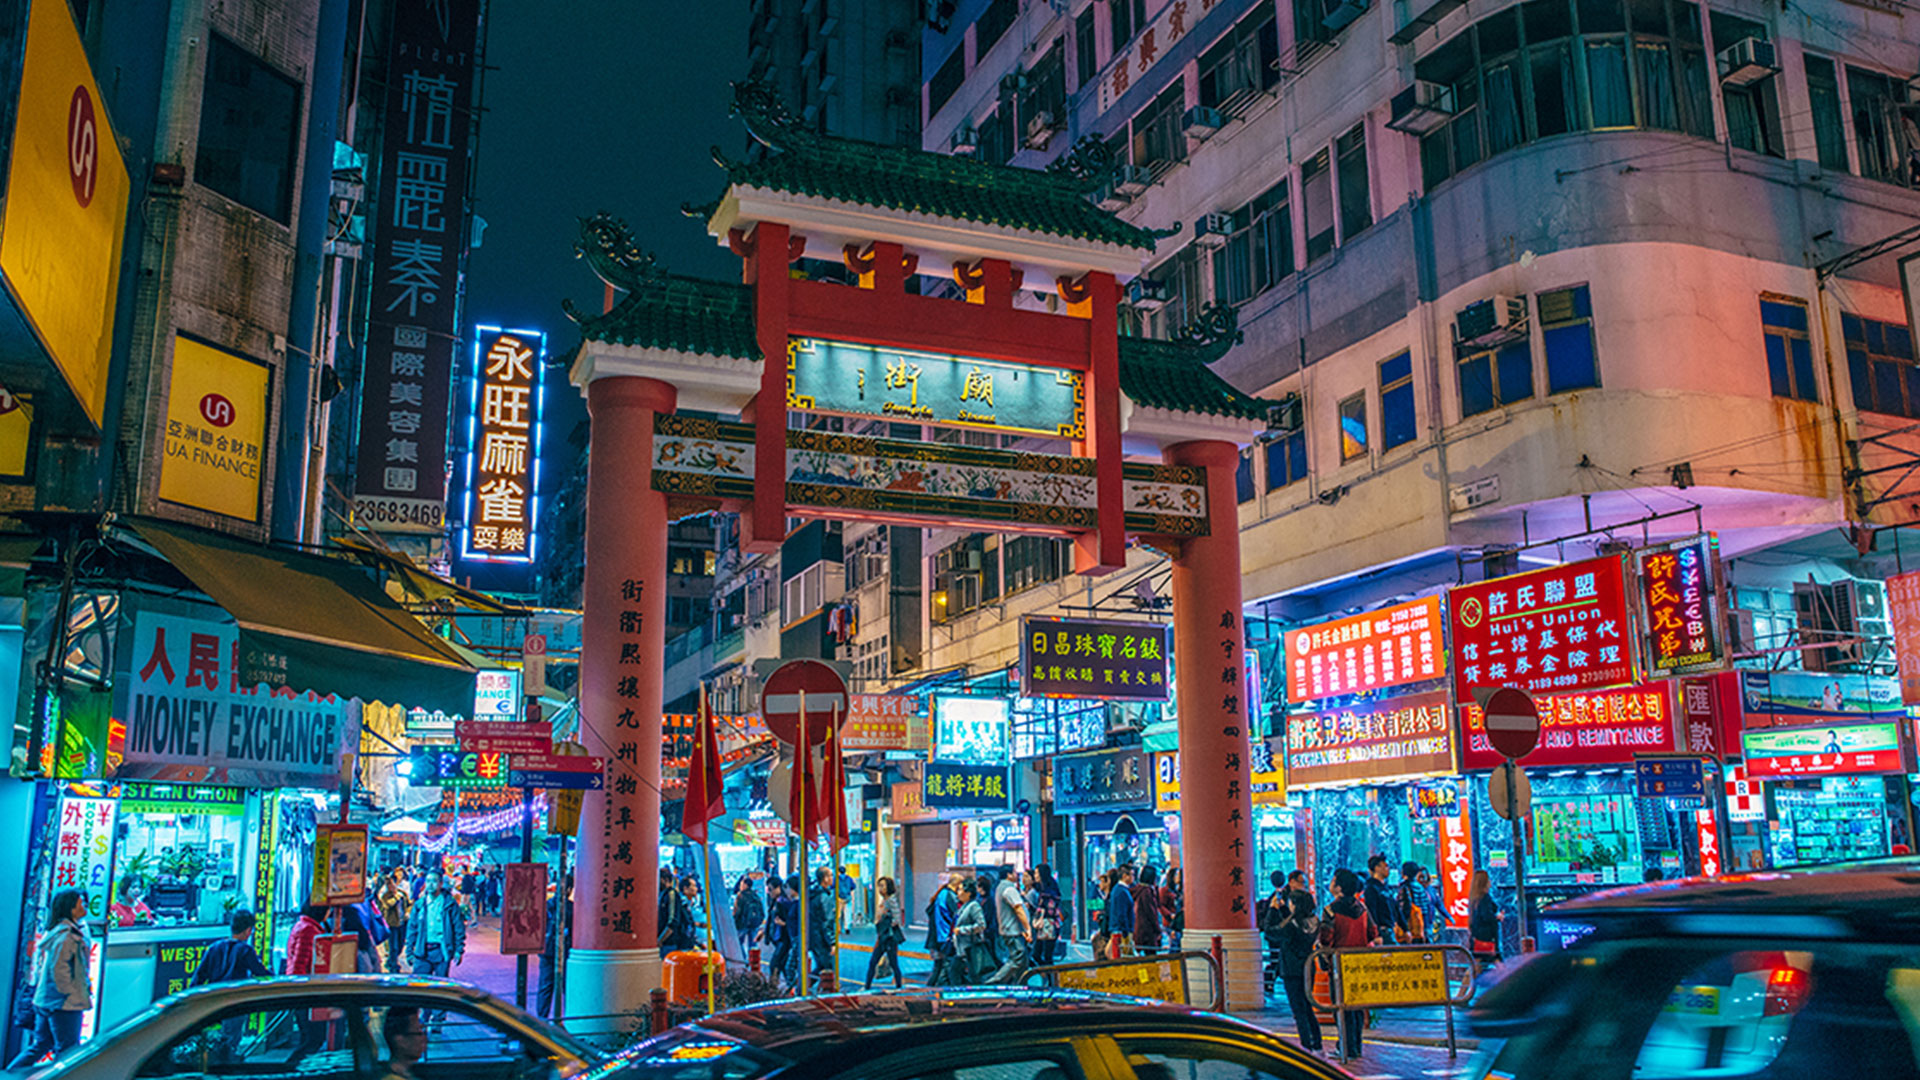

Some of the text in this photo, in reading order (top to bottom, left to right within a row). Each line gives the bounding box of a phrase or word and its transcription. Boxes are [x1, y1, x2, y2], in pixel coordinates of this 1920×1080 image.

[383, 324, 428, 492] 國際美容集團
[882, 400, 996, 425] Temple Street
[168, 419, 259, 461] 亞洲聯合財務
[479, 336, 533, 523] 永旺麻雀
[165, 441, 257, 480] UA FINANCE
[355, 499, 442, 527] 23683469
[1488, 573, 1597, 615] 許氏聯盟
[1489, 608, 1601, 636] Hui's Union
[1032, 631, 1162, 660] 日昌珠寶名錶
[1528, 676, 1553, 690] 3189
[1553, 673, 1578, 687] 4899
[132, 694, 336, 766] MONEY EXCHANGE
[1686, 685, 1715, 752] 匯款
[1546, 730, 1574, 749] AND
[1578, 725, 1665, 746] REMITTANCE
[122, 783, 238, 801] STERN UNION
[925, 773, 1007, 799] 龍將洋服
[85, 801, 96, 845] MONEY
